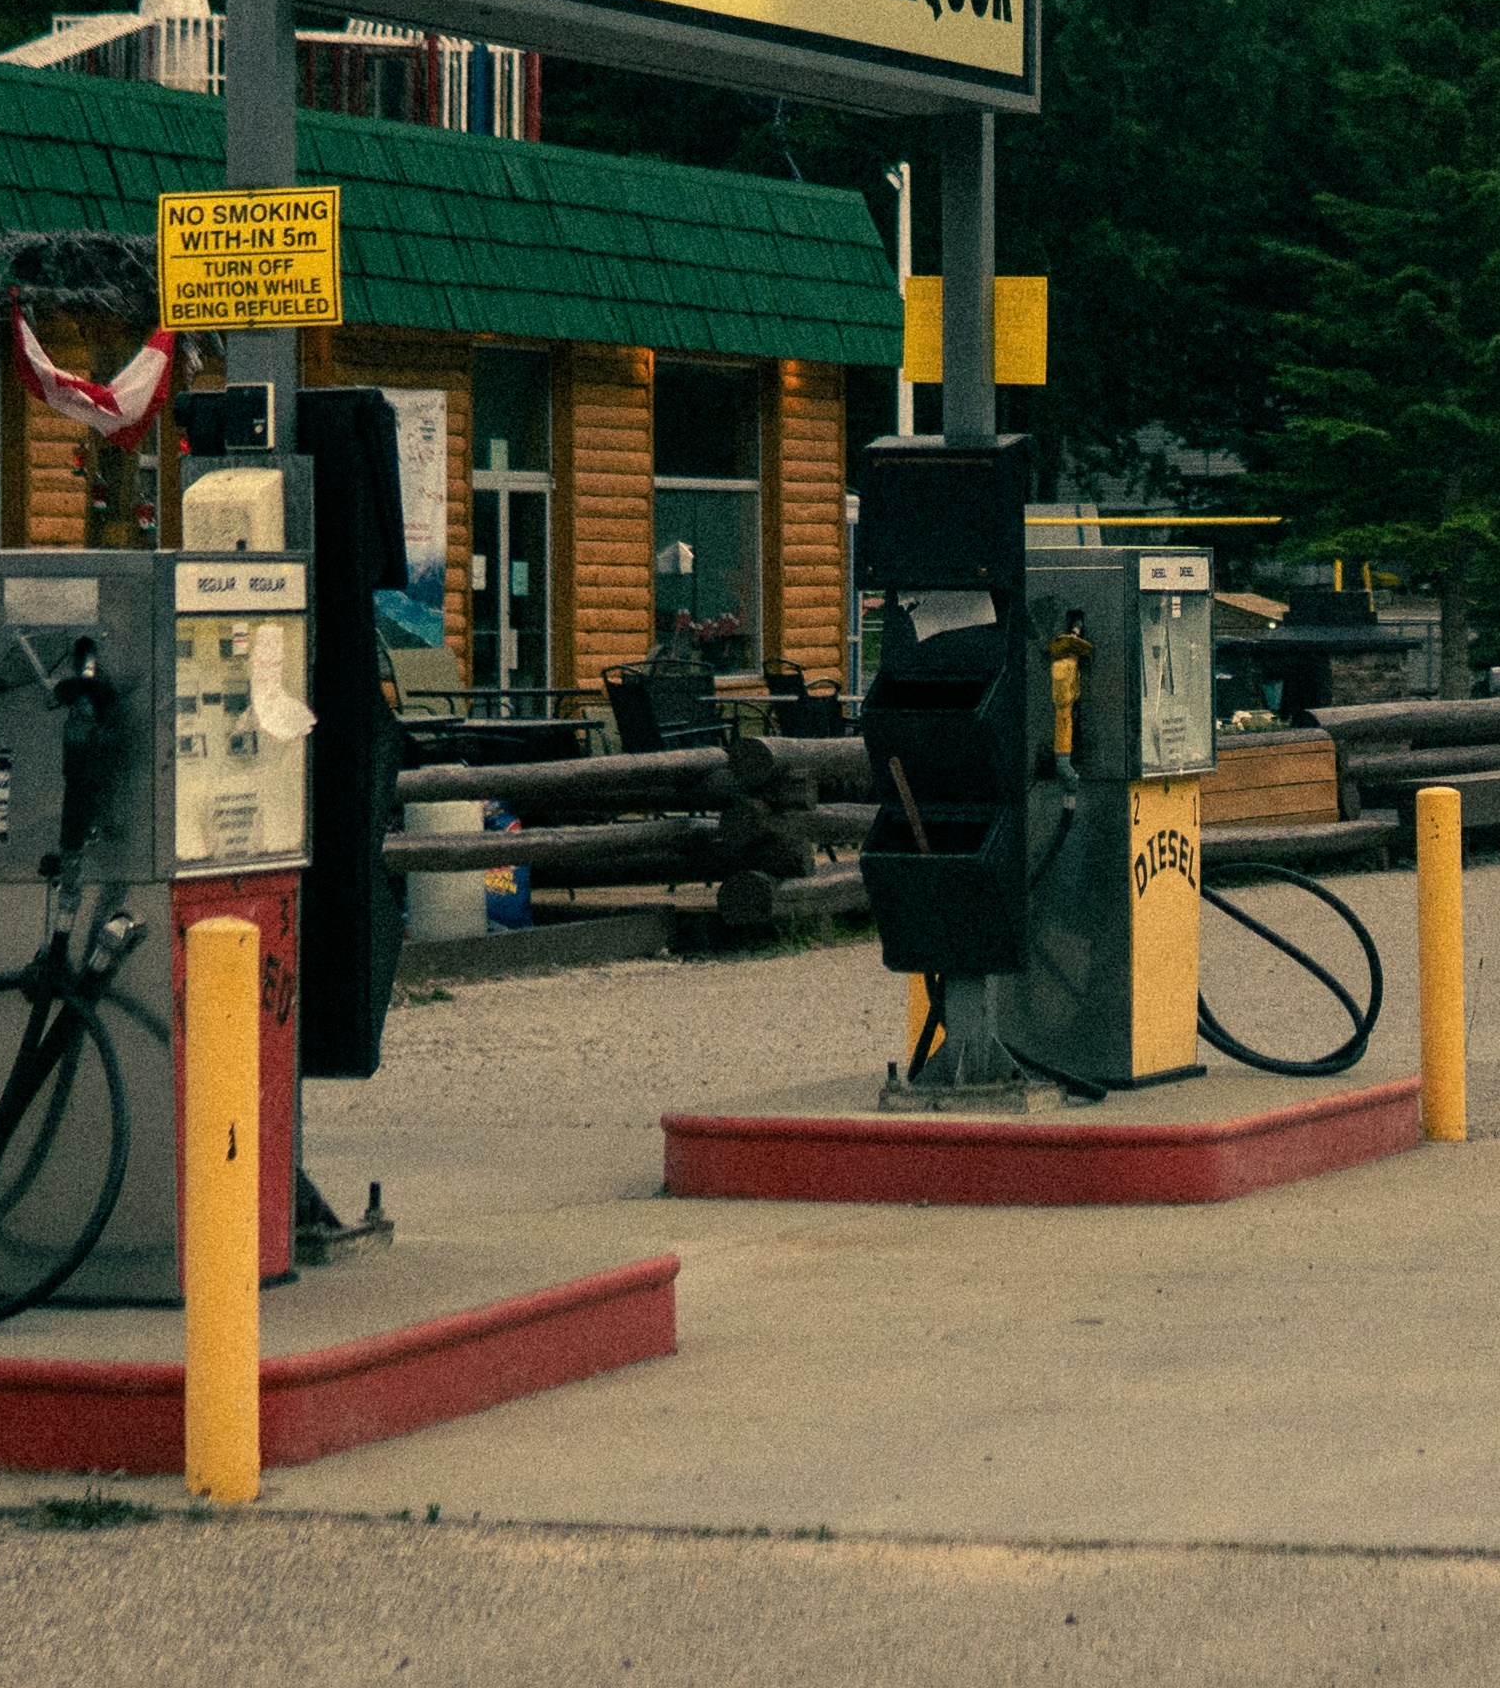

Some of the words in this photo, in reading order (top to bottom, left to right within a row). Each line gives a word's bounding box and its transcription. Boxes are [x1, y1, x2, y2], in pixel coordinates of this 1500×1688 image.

[169, 206, 204, 226] NO
[213, 200, 328, 224] SMOKING
[181, 228, 275, 251] WITH-IN
[282, 227, 317, 246] 5m
[203, 260, 252, 277] TURN
[258, 258, 294, 276] OFF
[176, 280, 258, 299] IGNITION
[263, 278, 322, 296] WHILE
[172, 301, 228, 320] BEING
[234, 298, 329, 317] REFUELED
[198, 576, 237, 592] REGULAR
[249, 576, 286, 592] REGULAR
[1133, 792, 1141, 826] 2
[1133, 829, 1197, 898] DIESEL
